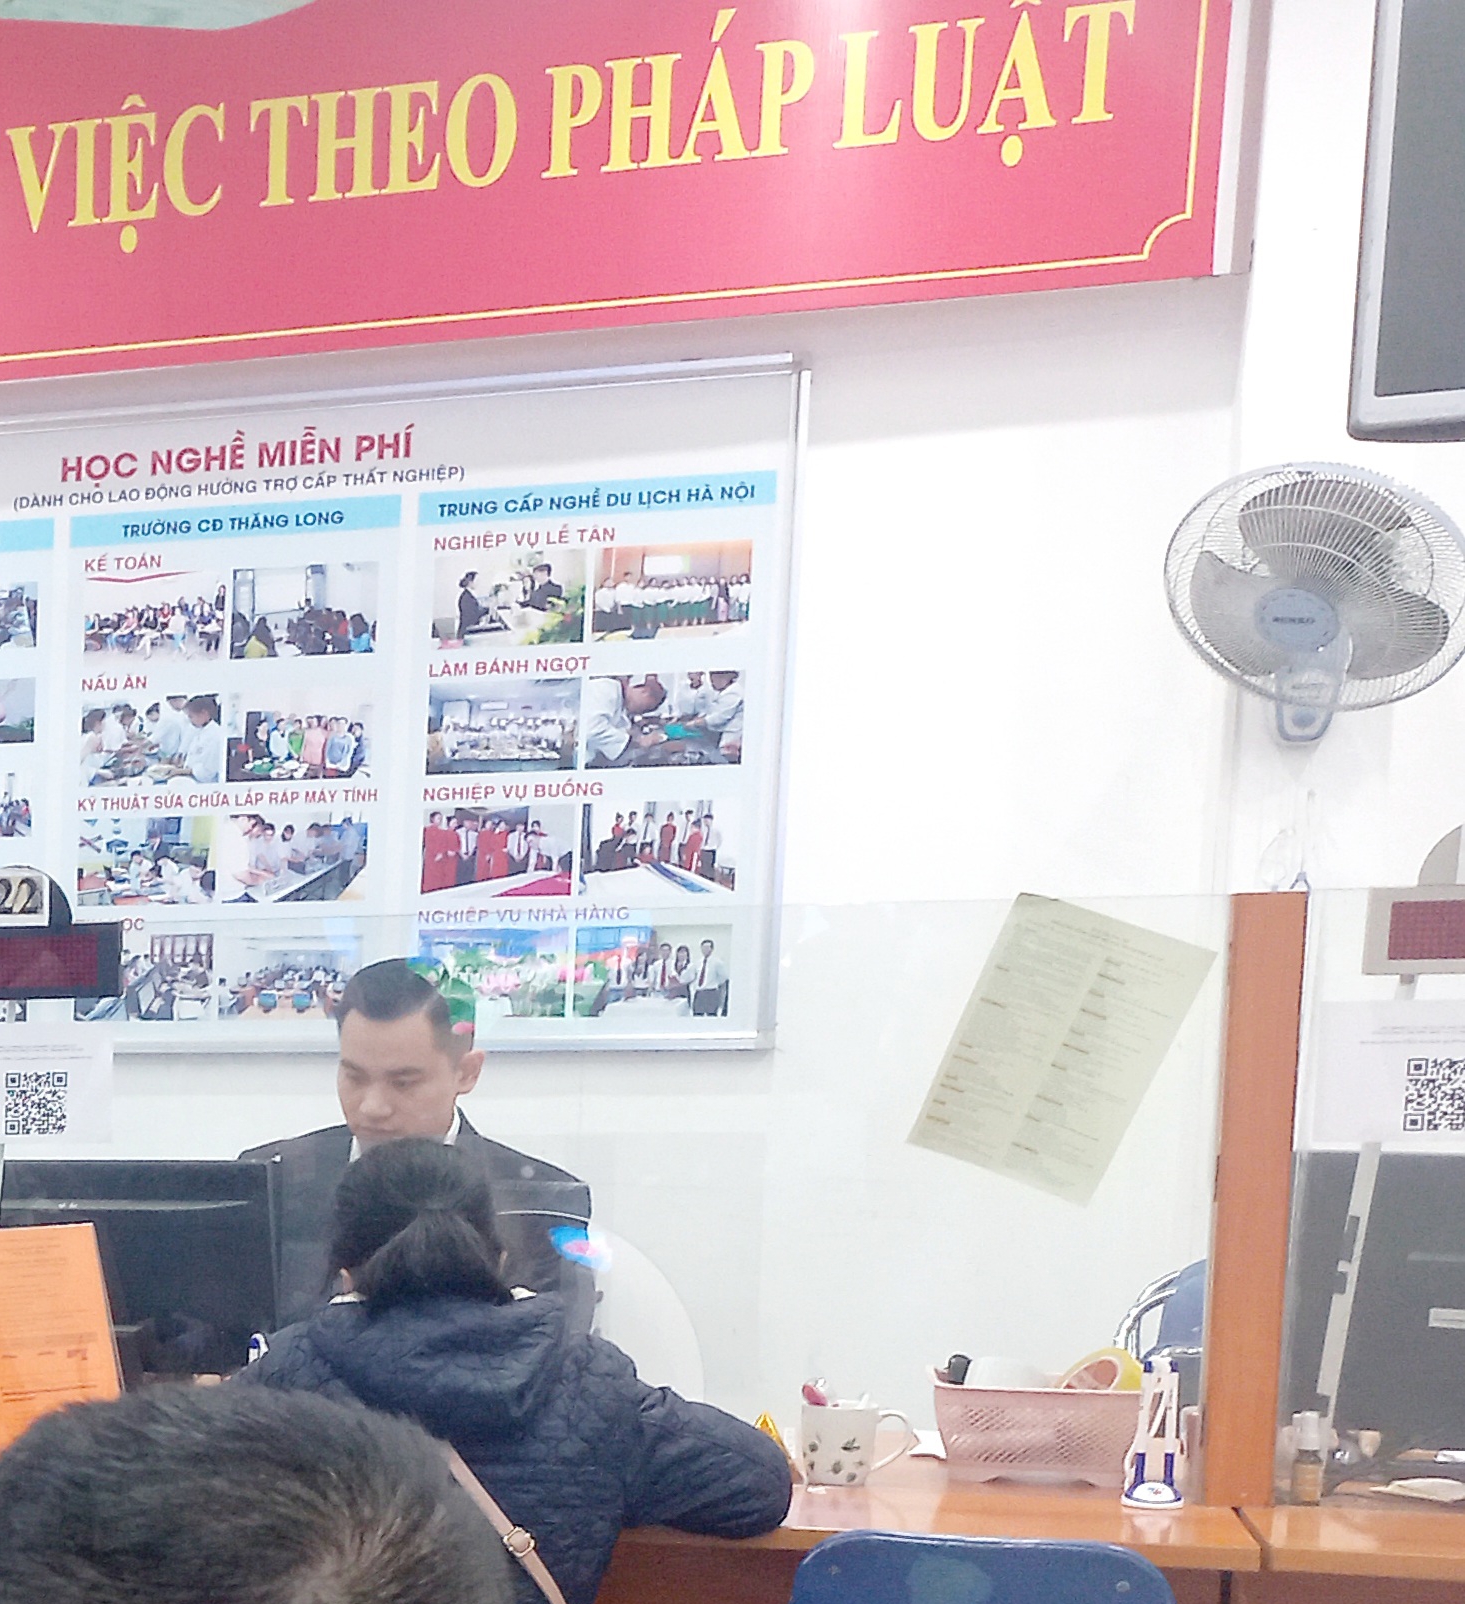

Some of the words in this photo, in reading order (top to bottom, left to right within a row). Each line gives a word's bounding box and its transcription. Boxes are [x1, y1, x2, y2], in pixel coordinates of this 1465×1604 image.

[6, 94, 225, 254] VIỆC
[250, 72, 519, 209] THEO
[540, 8, 816, 179] PHÁP
[832, 0, 1135, 168] LUẬT
[61, 451, 138, 488] HỌC
[150, 430, 246, 476] NGHỀ
[257, 426, 342, 468] MIỄN
[354, 423, 416, 462] PHÍ
[13, 491, 64, 513] (DÀNH
[69, 489, 104, 506] CHO
[108, 487, 140, 503] LAO
[144, 482, 192, 502] ĐỘNG
[262, 475, 299, 495] TRỢ
[302, 469, 337, 489] CẤP
[342, 466, 386, 485] THẤT
[392, 464, 466, 484] NGHIỆP)
[438, 500, 498, 517] TRUNG
[504, 492, 543, 514] CẤP
[549, 486, 600, 510] NGHỀ
[606, 491, 631, 507] DU
[638, 488, 680, 509] LỊCH
[687, 482, 714, 502] HÀ
[720, 480, 755, 502] NỘI
[121, 519, 191, 539] TRƯỜNG
[197, 517, 223, 533] CĐ
[229, 511, 288, 531] THĂNG
[295, 509, 344, 527] LONG
[434, 531, 507, 551] NGHIỆP
[513, 531, 539, 550] VỤ
[114, 551, 162, 571] TOÁN
[428, 659, 468, 678] LÀM
[475, 657, 529, 676] BÁNH
[536, 655, 591, 675] NGỌT
[188, 790, 230, 807] CHỮA
[269, 788, 299, 805] RÁP
[305, 786, 337, 804] MÁY
[343, 786, 379, 802] TÍNH
[423, 782, 495, 804] NGHIỆP
[502, 784, 528, 802] VỤ
[527, 904, 567, 923] NHÀ
[575, 903, 629, 922] HÀNG
